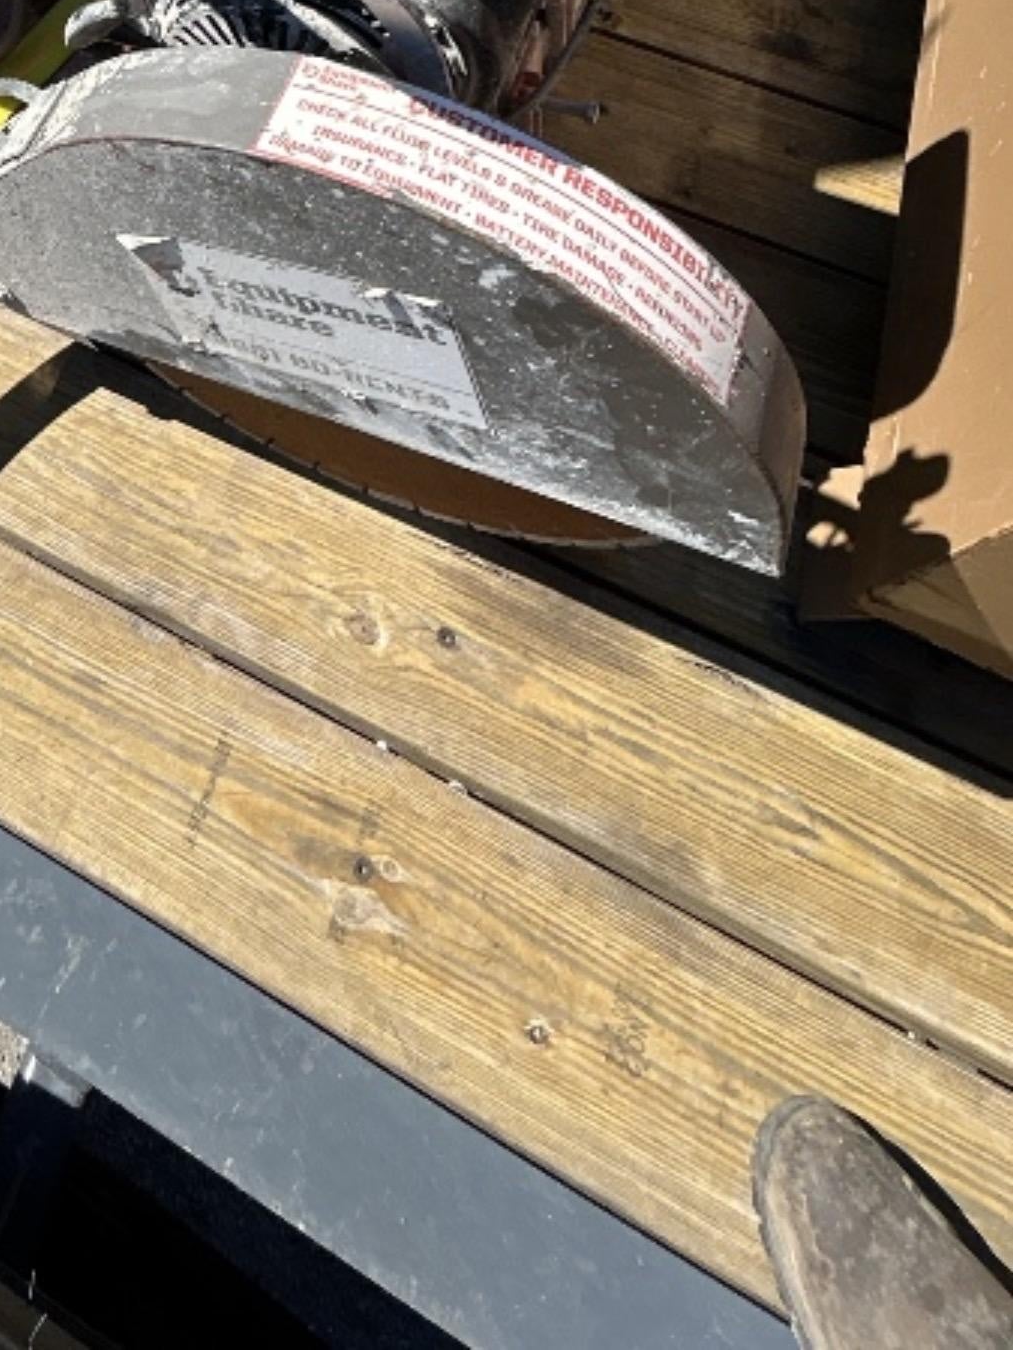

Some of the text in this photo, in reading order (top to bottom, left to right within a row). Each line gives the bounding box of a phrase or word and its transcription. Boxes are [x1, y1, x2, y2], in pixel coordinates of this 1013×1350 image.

[297, 99, 349, 121] CHECK
[350, 115, 378, 133] ALL
[574, 217, 618, 254] DAILY
[410, 95, 558, 176] CUSTOMER
[419, 163, 458, 187] FLAT
[562, 238, 627, 288] DAMAGE
